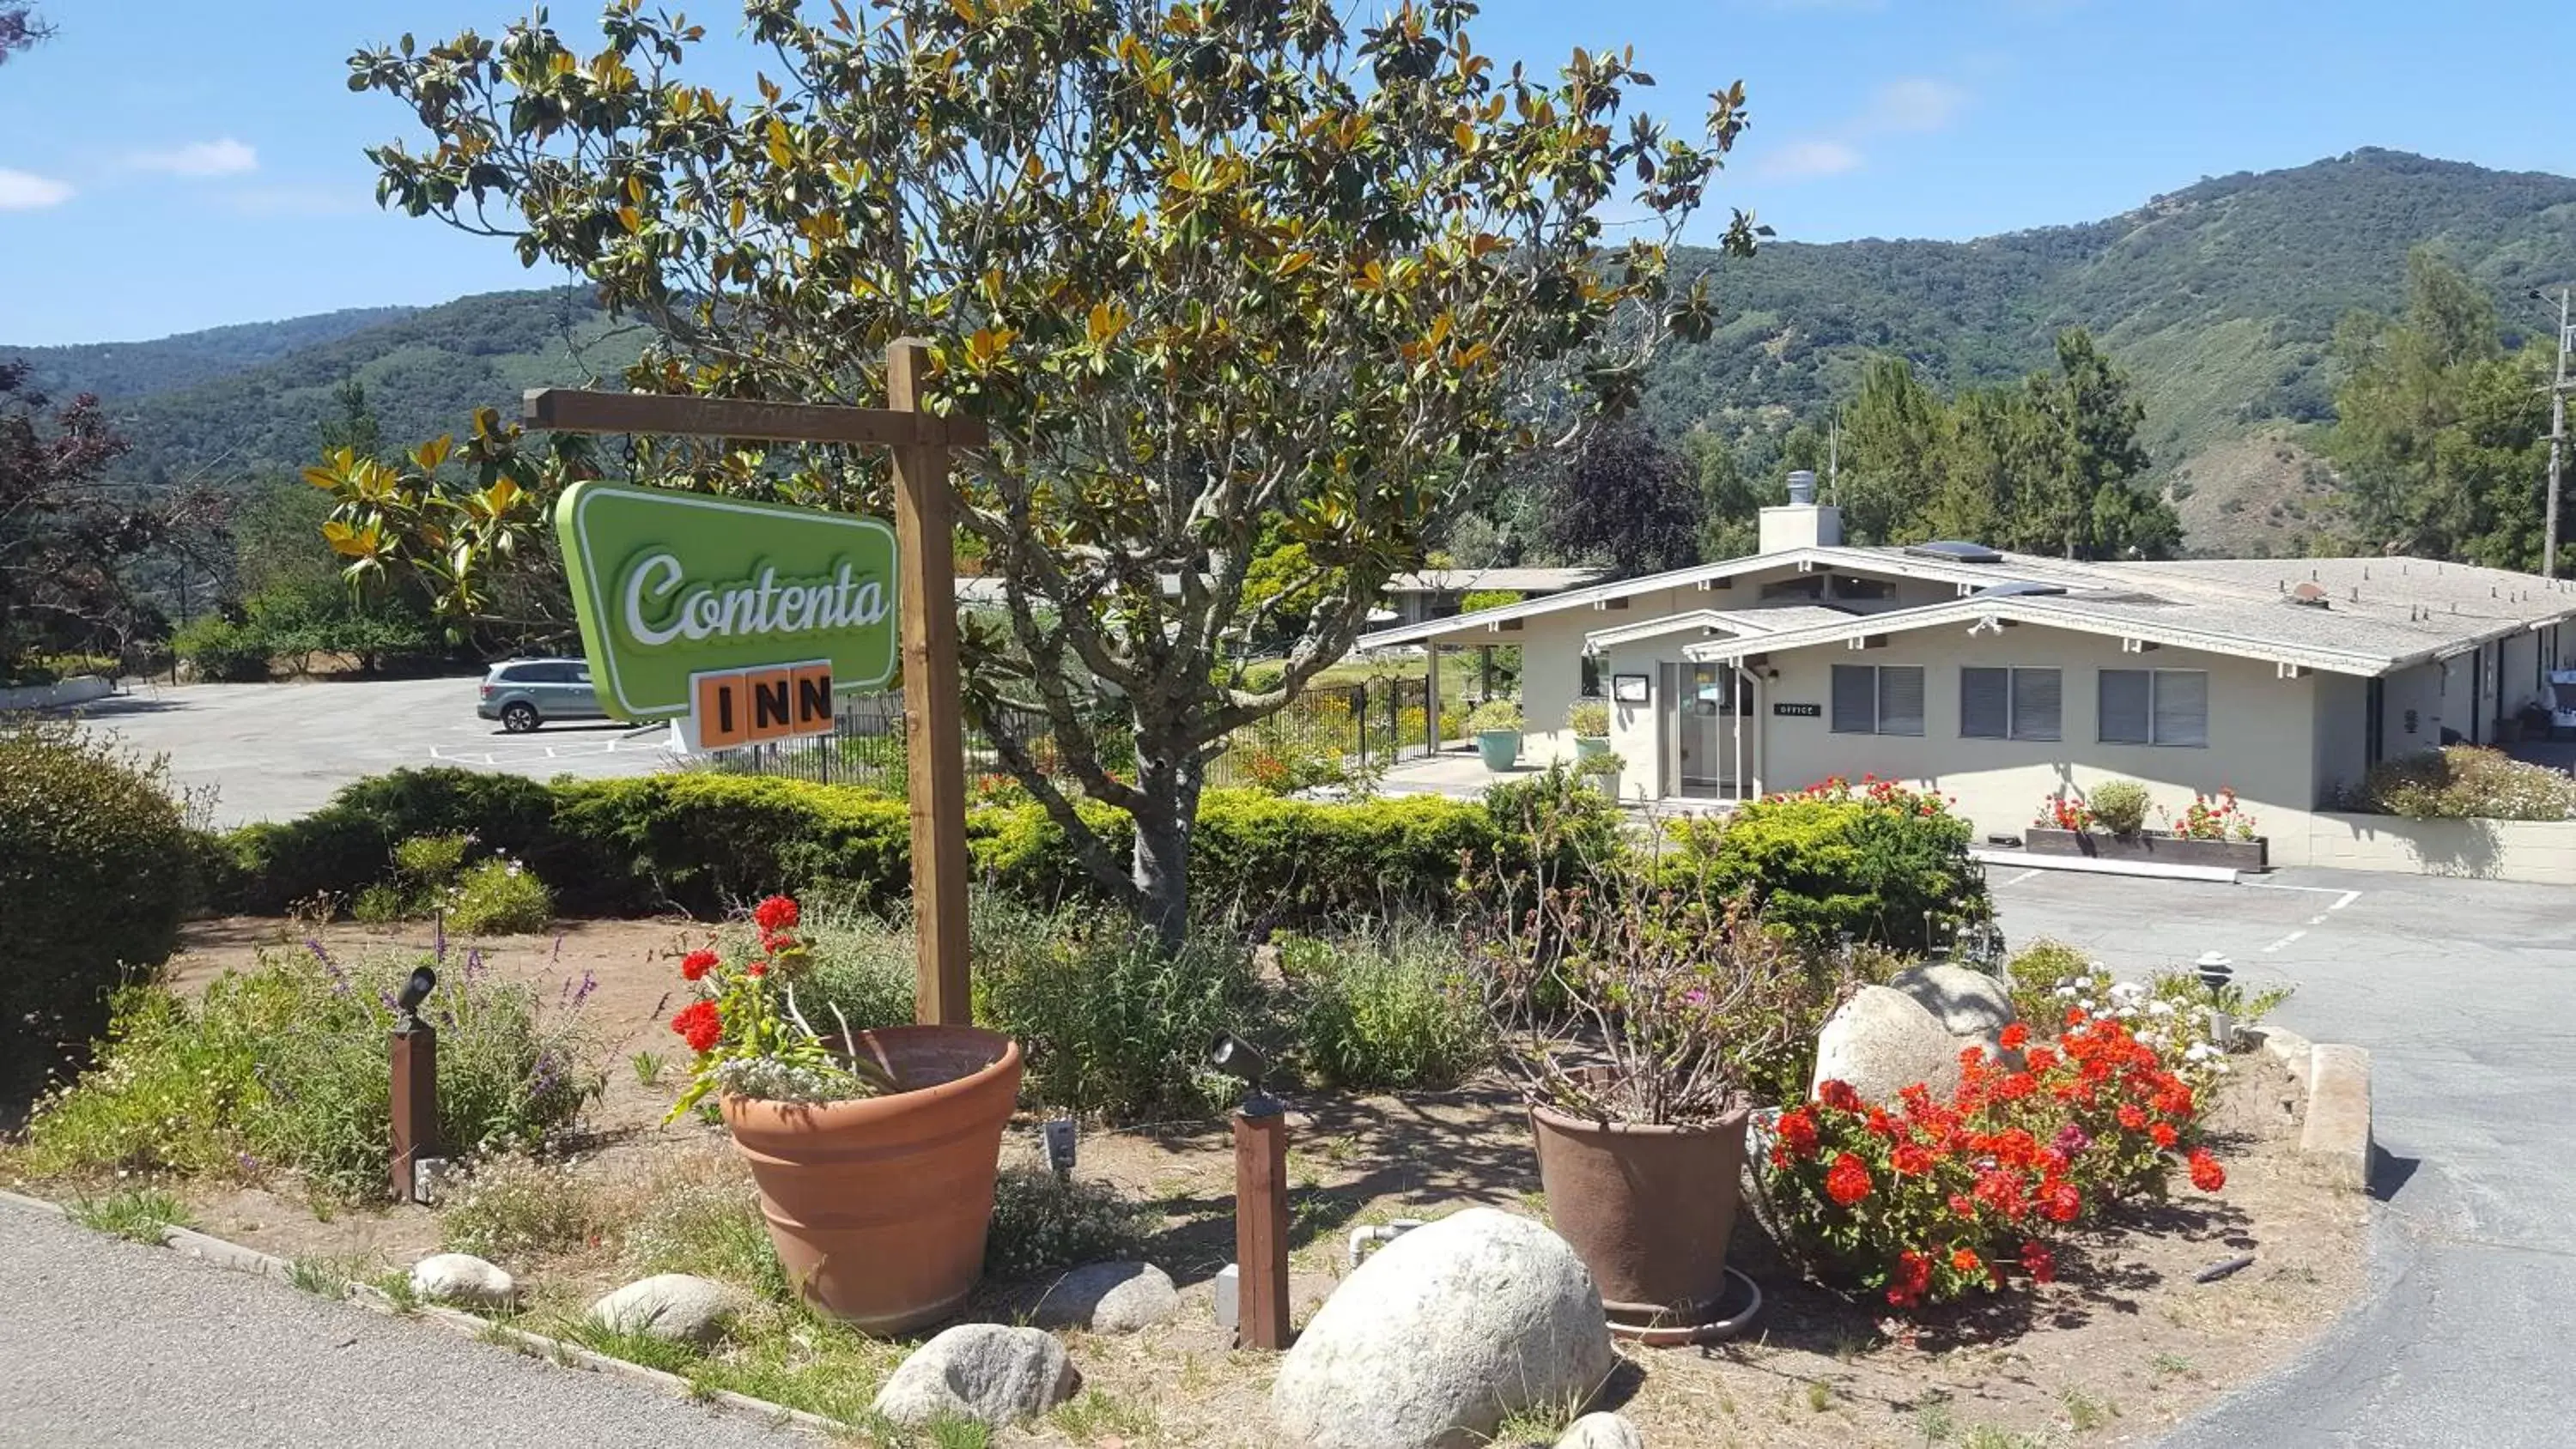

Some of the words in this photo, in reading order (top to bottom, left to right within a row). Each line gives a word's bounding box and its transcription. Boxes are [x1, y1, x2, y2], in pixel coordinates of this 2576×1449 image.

[626, 554, 890, 646] Contenta
[719, 676, 831, 733] INN
[1780, 706, 1813, 715] OFFICE
